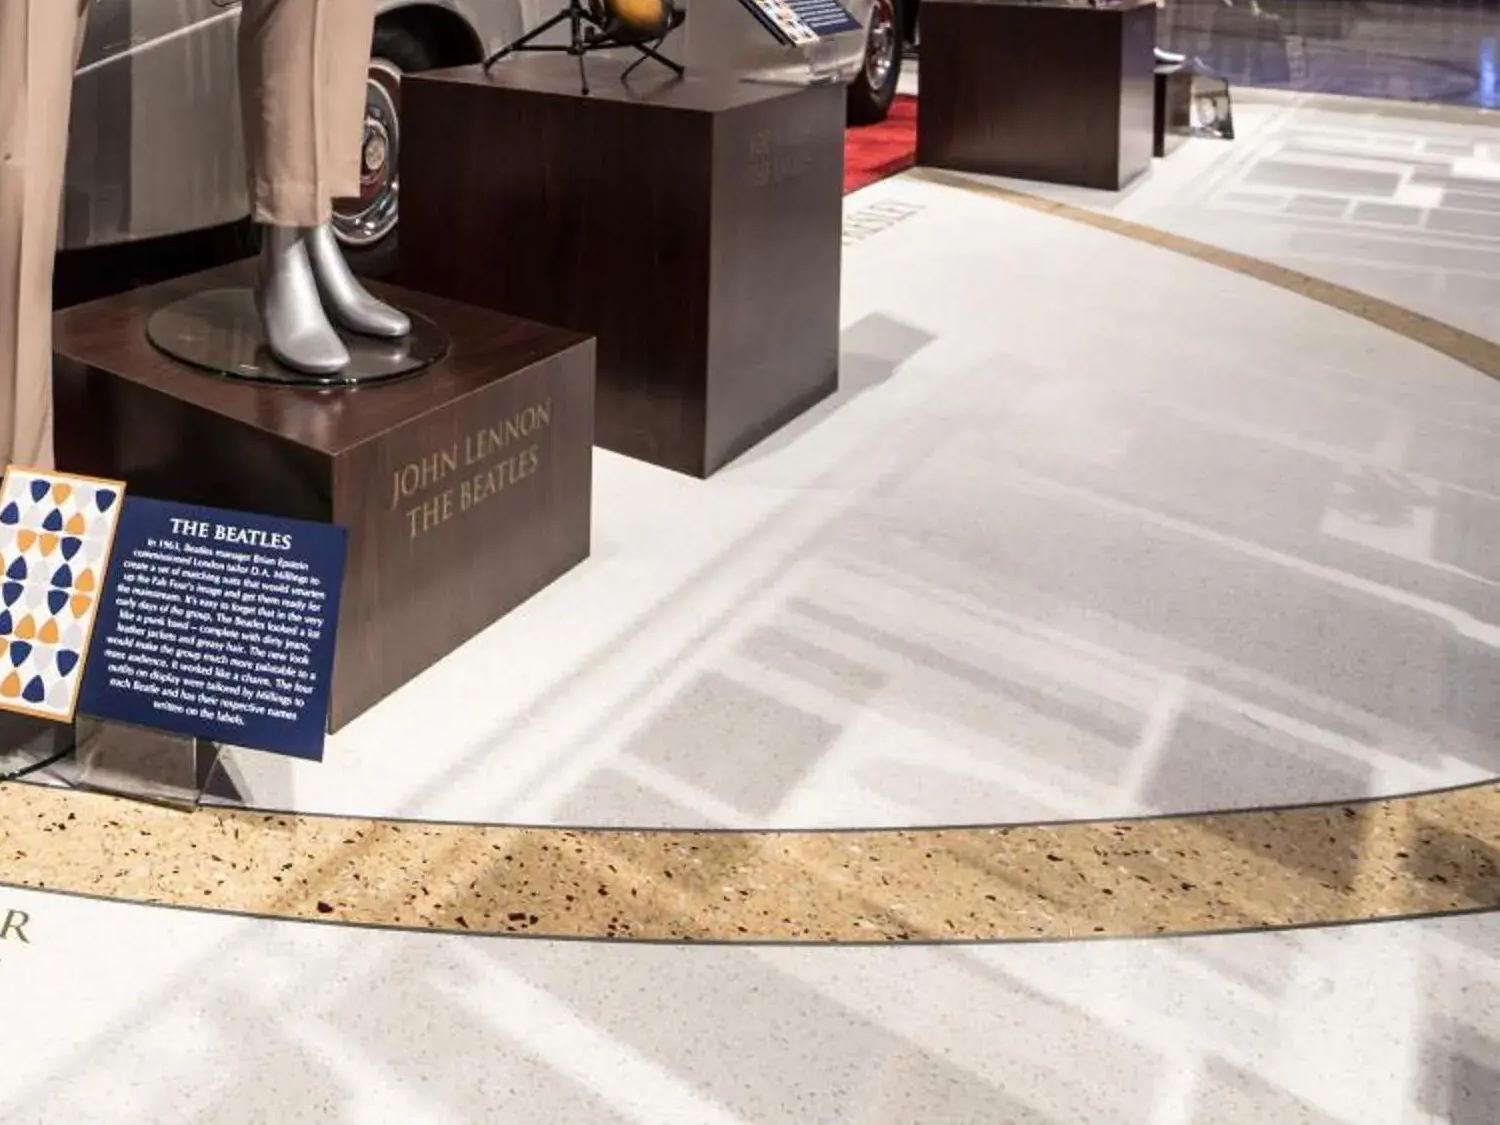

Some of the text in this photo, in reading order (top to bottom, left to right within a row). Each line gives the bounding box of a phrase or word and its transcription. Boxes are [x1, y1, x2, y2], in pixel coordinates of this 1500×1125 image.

[391, 398, 552, 510] JOHN LENNON
[406, 444, 540, 538] THE BEATLES
[169, 517, 292, 550] THE BEATLES
